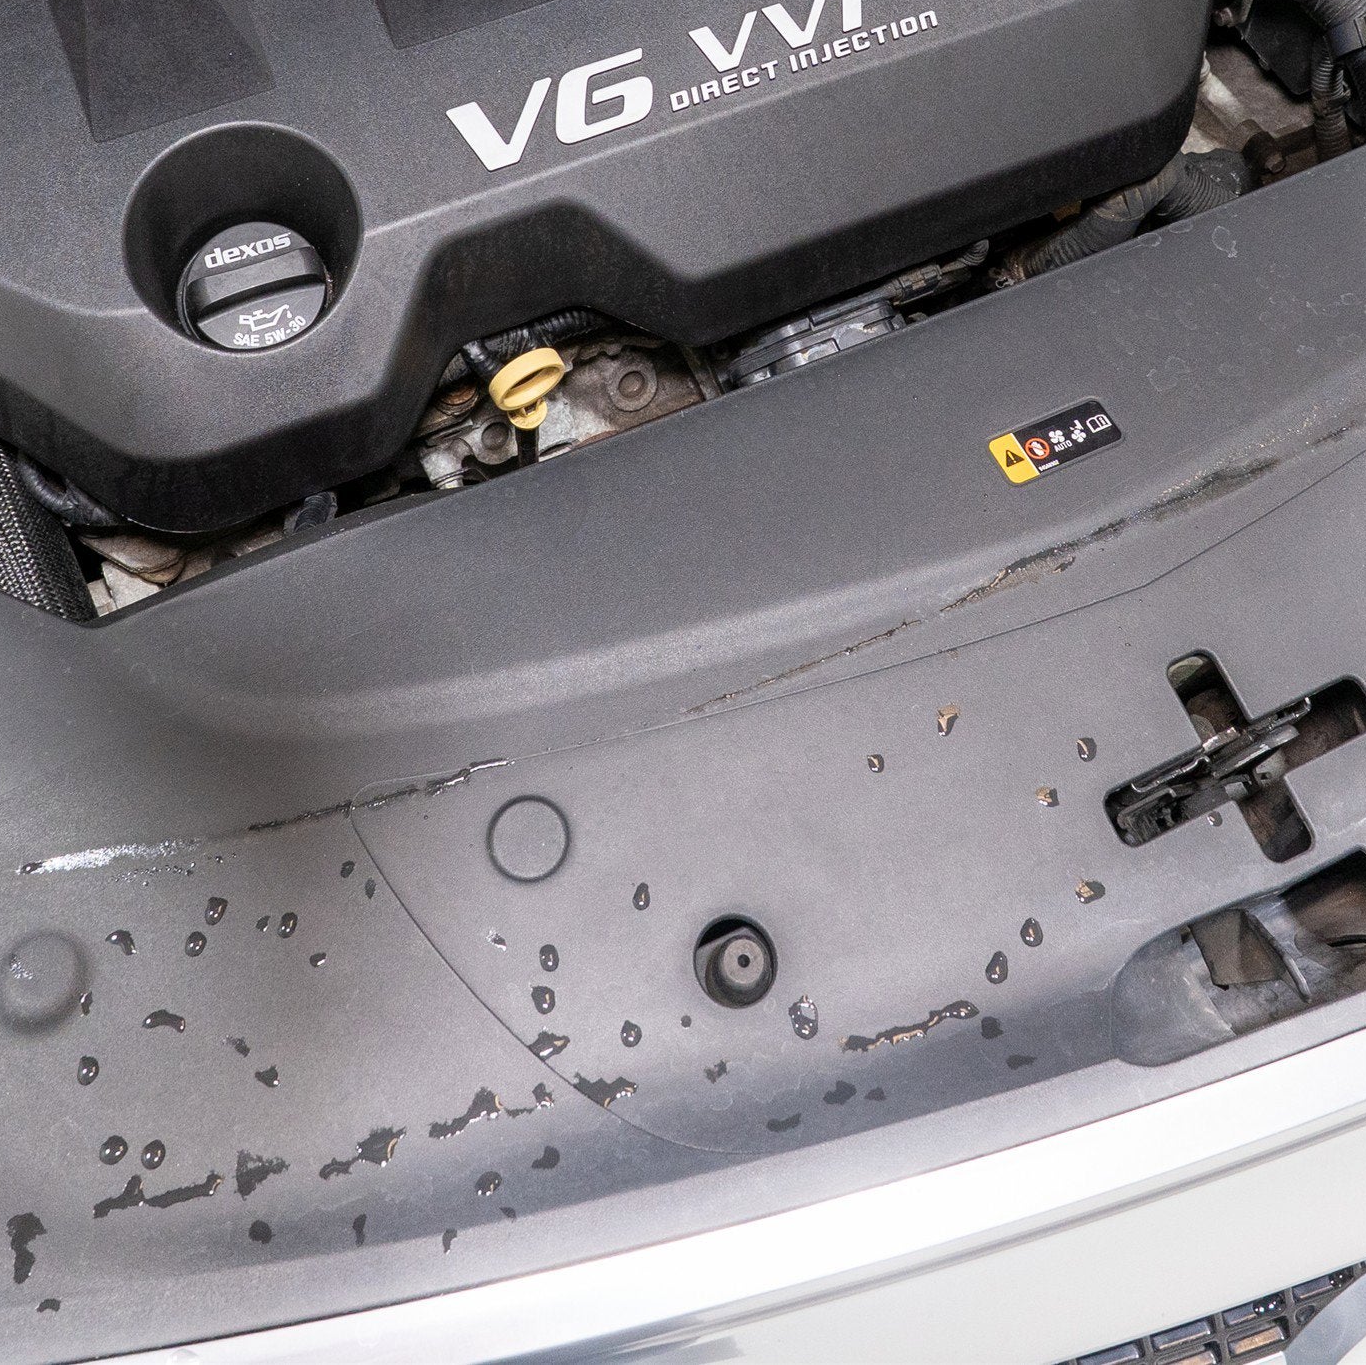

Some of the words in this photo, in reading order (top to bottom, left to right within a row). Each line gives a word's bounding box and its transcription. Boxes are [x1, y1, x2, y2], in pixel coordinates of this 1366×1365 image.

[670, 59, 777, 113] DIRECT
[789, 9, 938, 74] INJECTION
[446, 47, 654, 172] V6
[204, 232, 292, 269] dexos
[233, 332, 260, 347] SAE
[264, 315, 307, 345] 5W-30
[1054, 440, 1073, 452] AUTO
